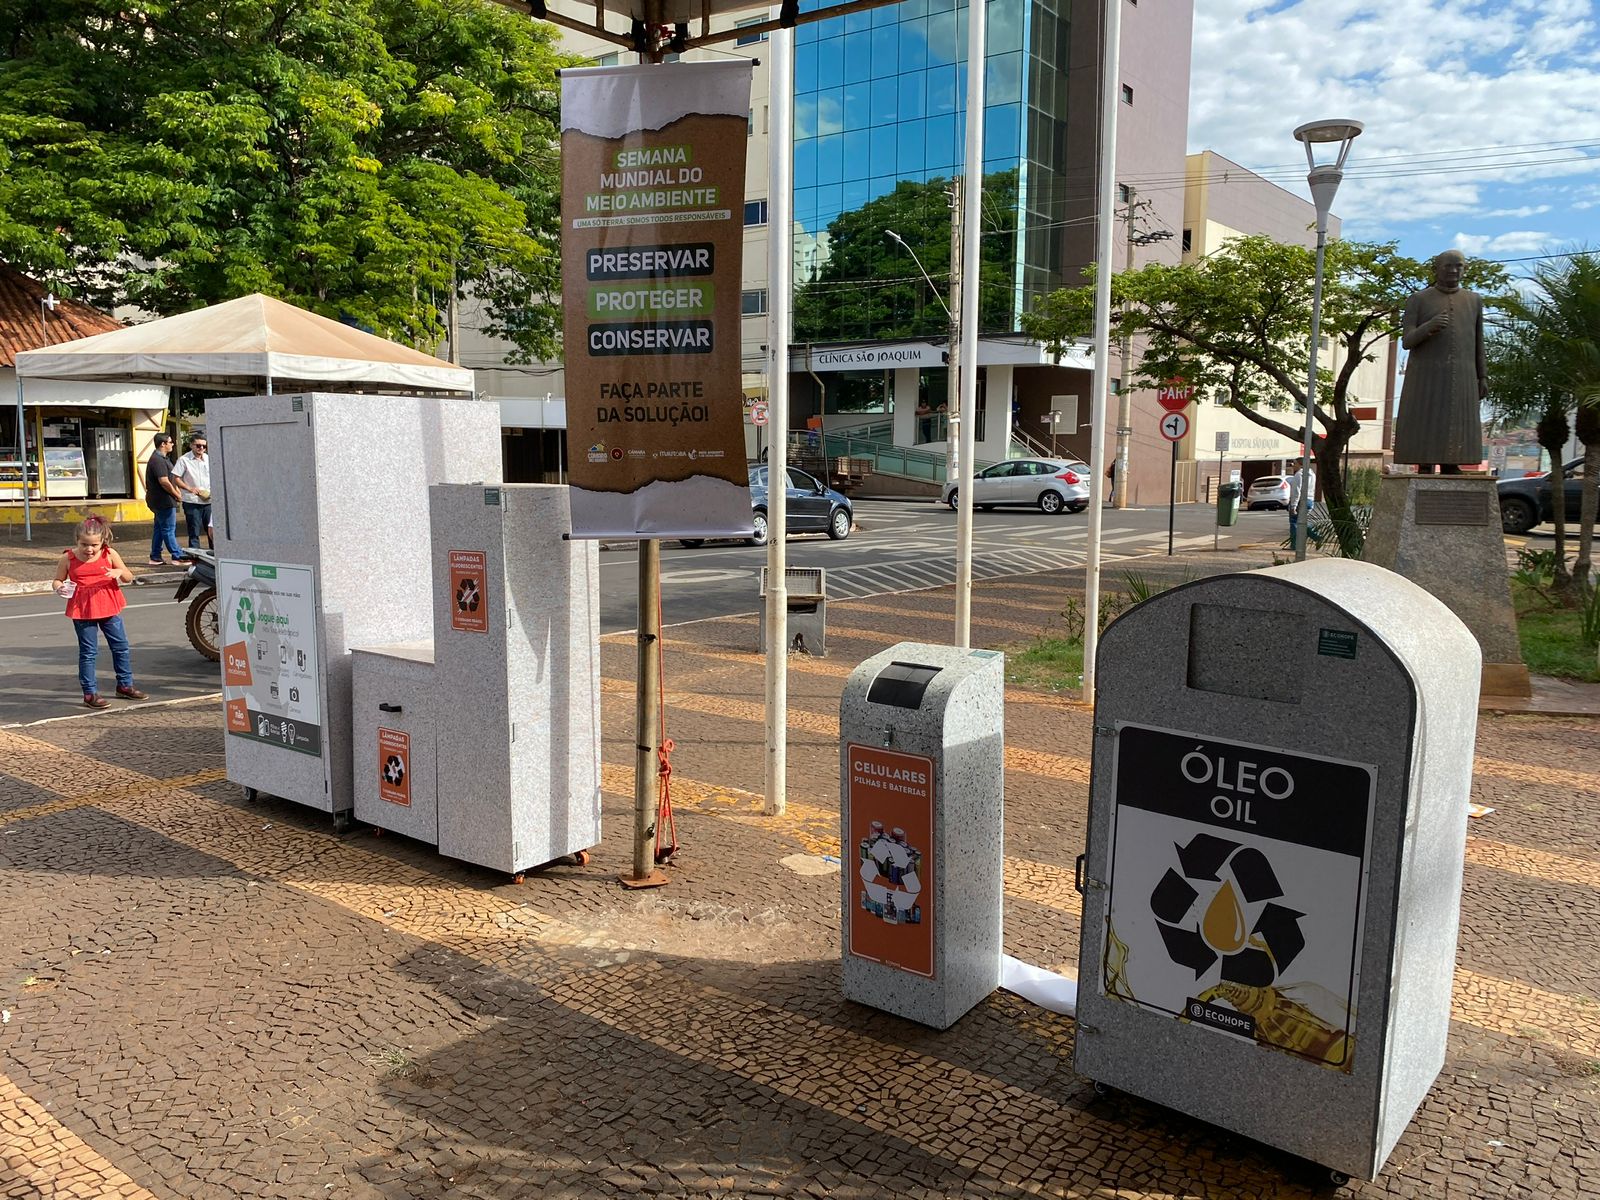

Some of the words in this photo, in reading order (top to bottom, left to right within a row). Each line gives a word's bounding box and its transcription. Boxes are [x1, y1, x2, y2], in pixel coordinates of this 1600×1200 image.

[617, 147, 687, 168] SEMANA
[600, 169, 676, 189] MUNDIAL
[678, 167, 703, 184] DO
[586, 194, 627, 211] MEIO
[629, 188, 716, 209] AMBIENTE
[577, 220, 591, 228] UMA
[592, 219, 601, 227] SÓ
[626, 216, 650, 225] SOMOS
[651, 214, 674, 223] TODOS
[674, 211, 726, 222] RESPONSÁVEIS
[590, 248, 710, 273] PRESERVAR
[596, 288, 703, 311] PROTEGER
[590, 327, 710, 350] CONSERVAR
[819, 352, 854, 364] CLÍNICA
[856, 350, 875, 362] SÃO
[877, 350, 922, 363] JOAQUIM
[600, 382, 643, 403] FAÇA
[647, 381, 704, 398] PARTE
[597, 406, 621, 423] DA
[624, 402, 709, 427] SOLUÇÃO!
[258, 610, 275, 624] Jogue
[276, 614, 289, 627] aqui
[229, 654, 235, 666] O
[235, 659, 246, 669] que
[854, 760, 926, 785] CELULARES
[1180, 745, 1295, 800] ÓLEO
[854, 775, 881, 788] PILHAS
[882, 781, 887, 790] E
[888, 783, 926, 797] BATERIAS
[1210, 795, 1257, 824] OIL
[1205, 1009, 1251, 1031] ECOHOPE
